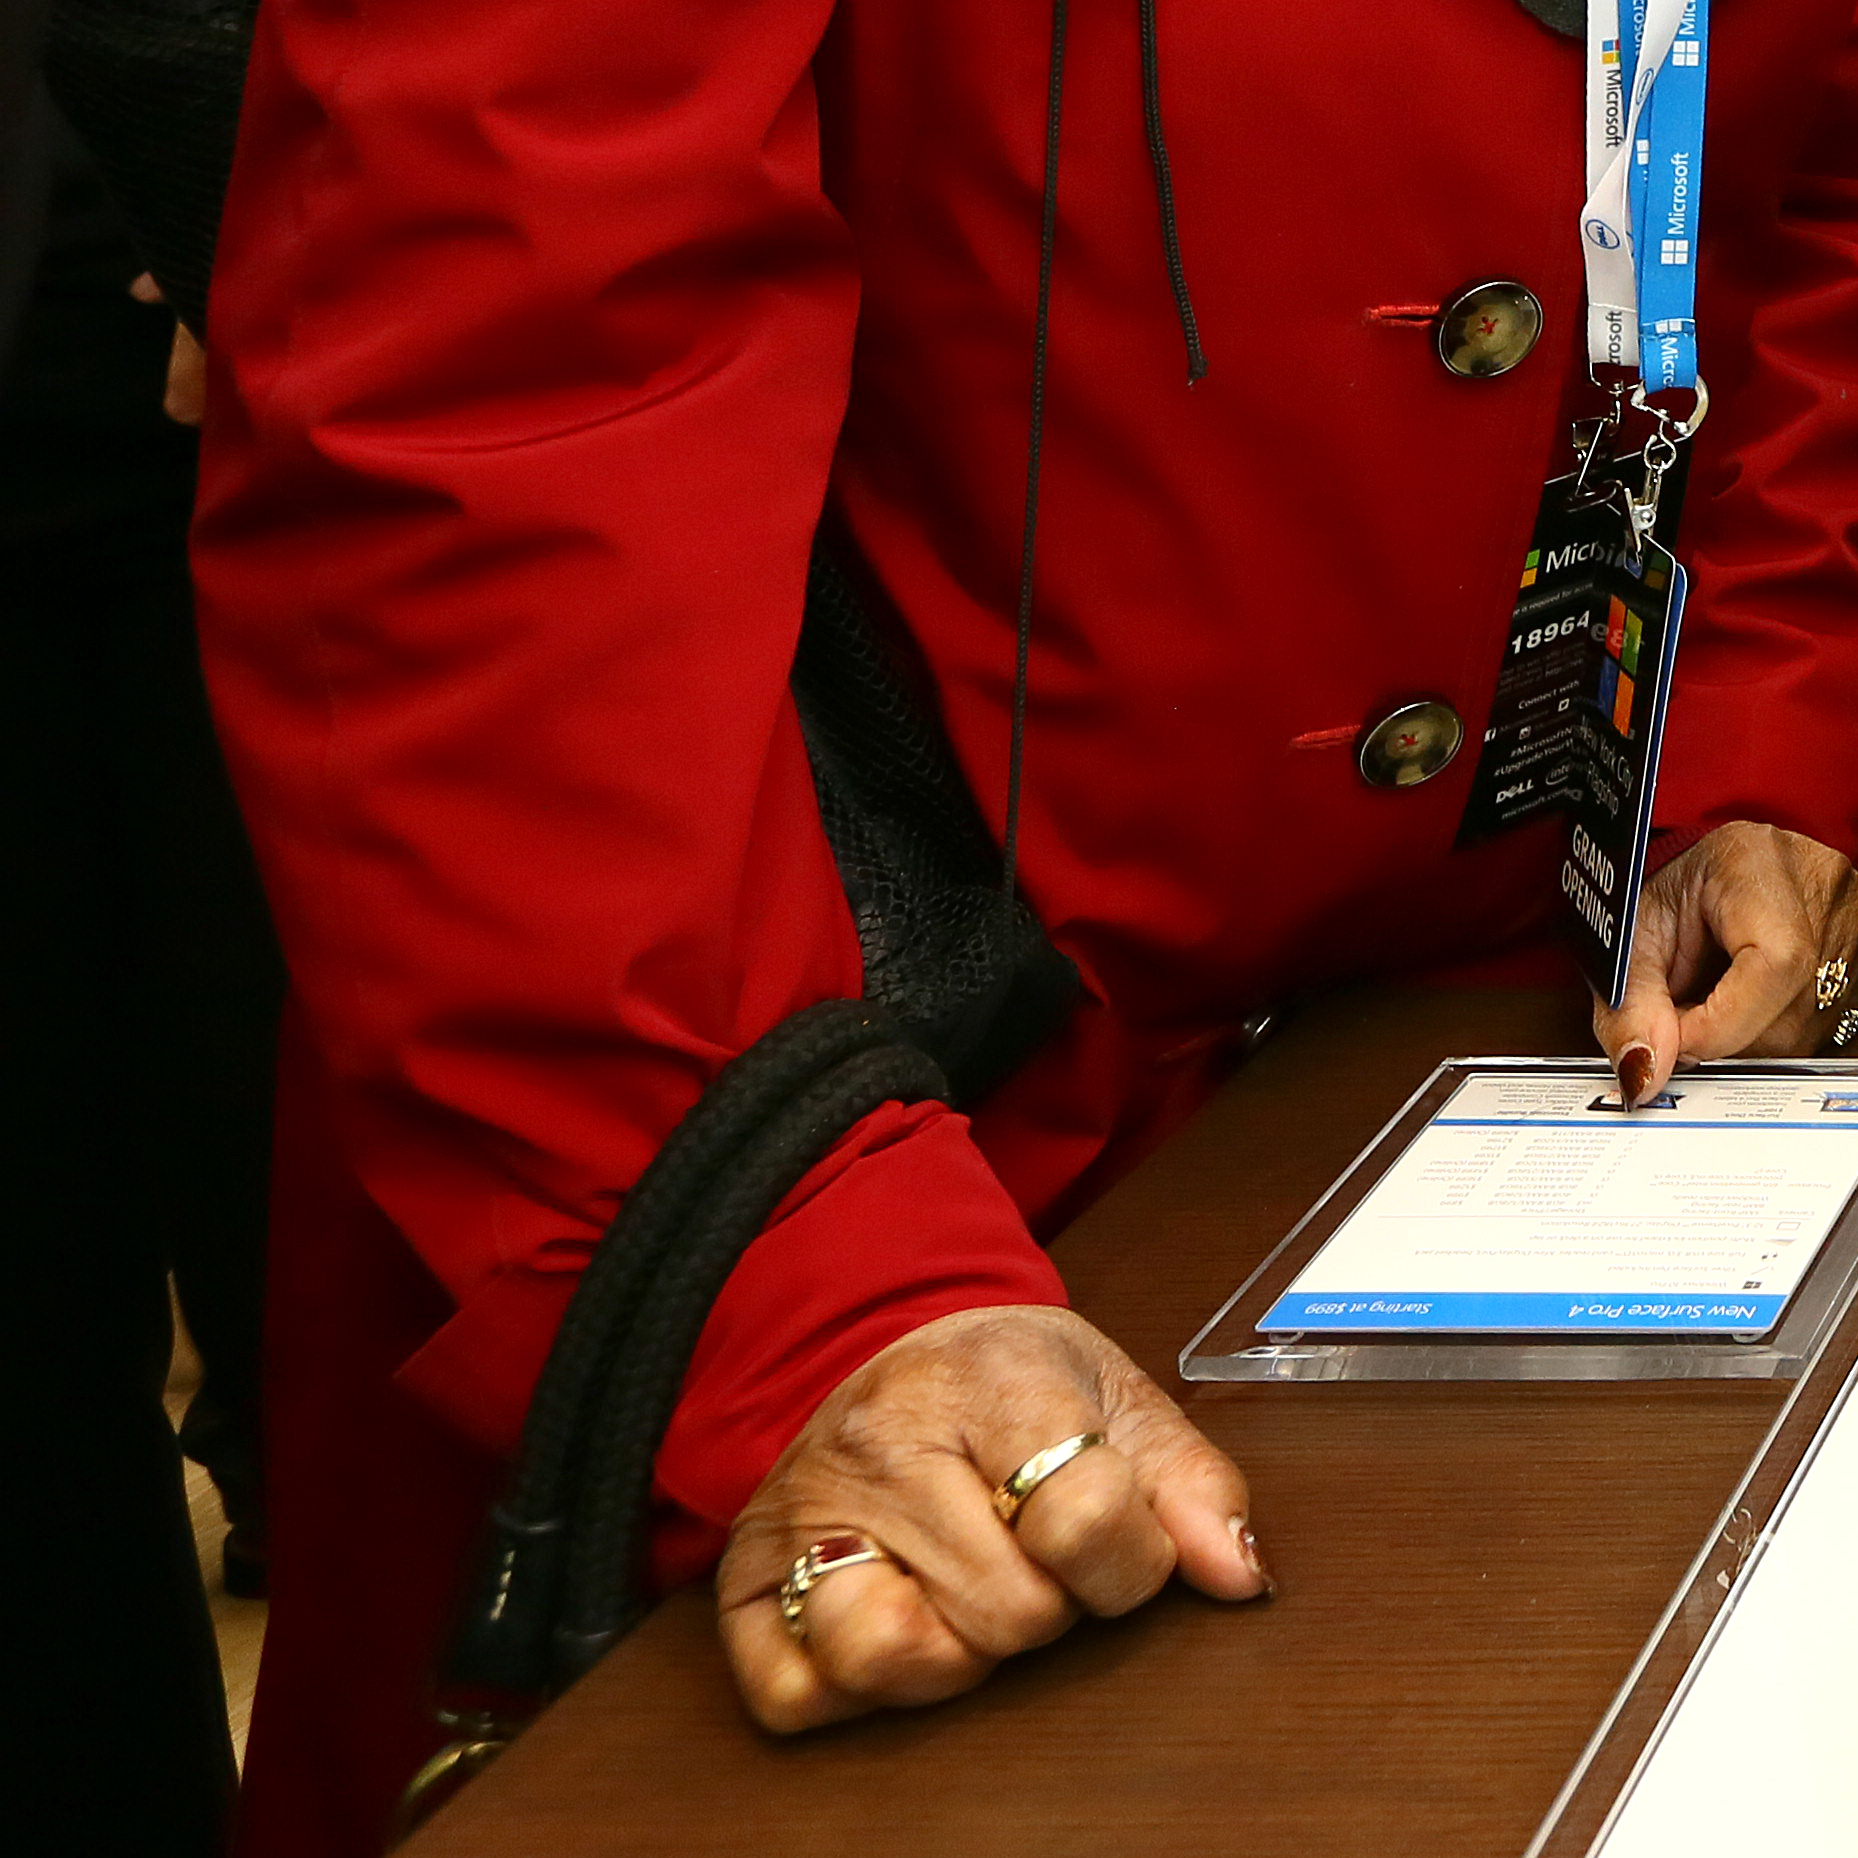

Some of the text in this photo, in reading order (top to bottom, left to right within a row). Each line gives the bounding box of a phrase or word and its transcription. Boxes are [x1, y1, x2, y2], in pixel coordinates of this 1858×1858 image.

[1606, 70, 1623, 148] Microsoft
[1667, 152, 1689, 235] Microsoft
[1511, 610, 1590, 655] 18964
[1518, 680, 1581, 710] Connect with
[1495, 779, 1534, 803] DELL
[1572, 823, 1615, 896] GRAND
[1561, 860, 1613, 949] OPENING
[1305, 1300, 1433, 1315] Starting at $899
[1568, 1304, 1757, 1319] New Surface Pro 4
